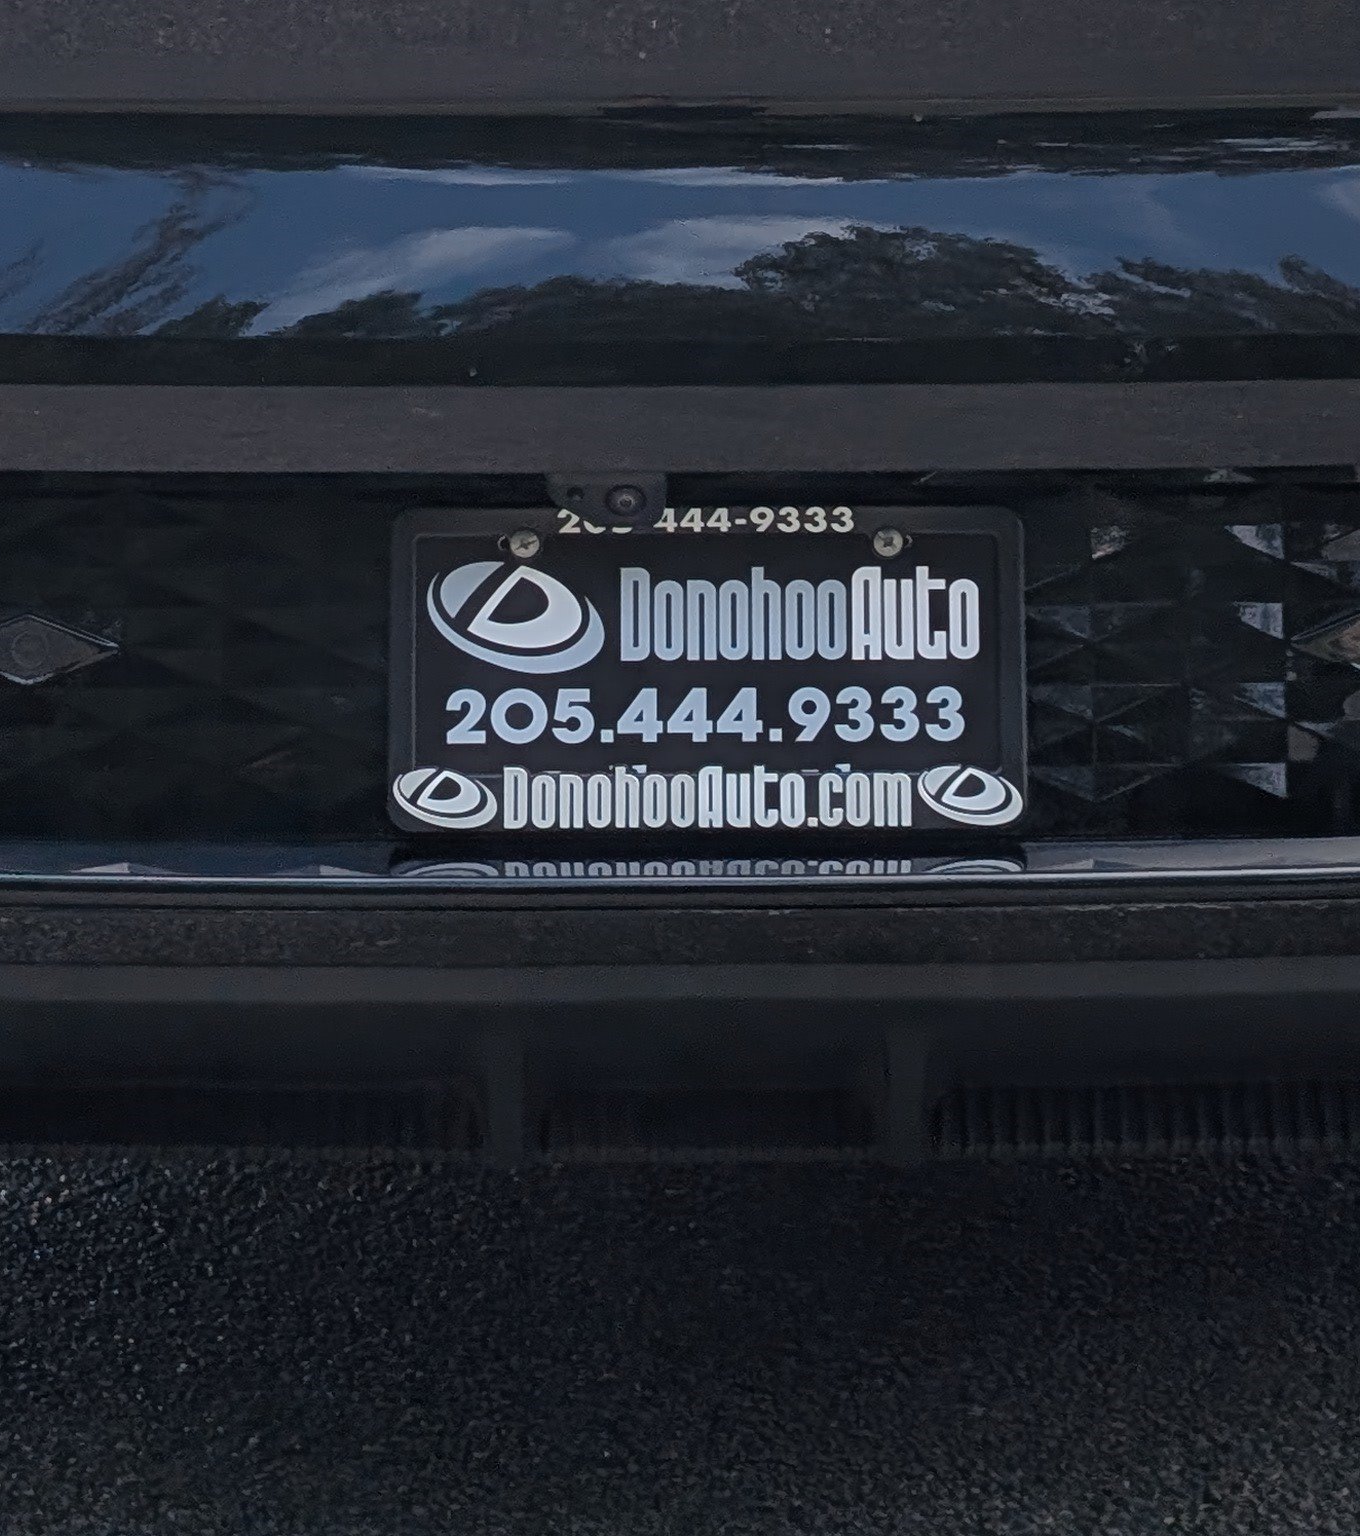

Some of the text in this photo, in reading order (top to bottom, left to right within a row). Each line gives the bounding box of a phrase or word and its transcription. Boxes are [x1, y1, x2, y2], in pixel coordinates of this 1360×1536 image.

[620, 565, 980, 662] DonohooAuto
[445, 685, 966, 745] 205.444.9333
[503, 765, 912, 830] DonohooAuto.com
